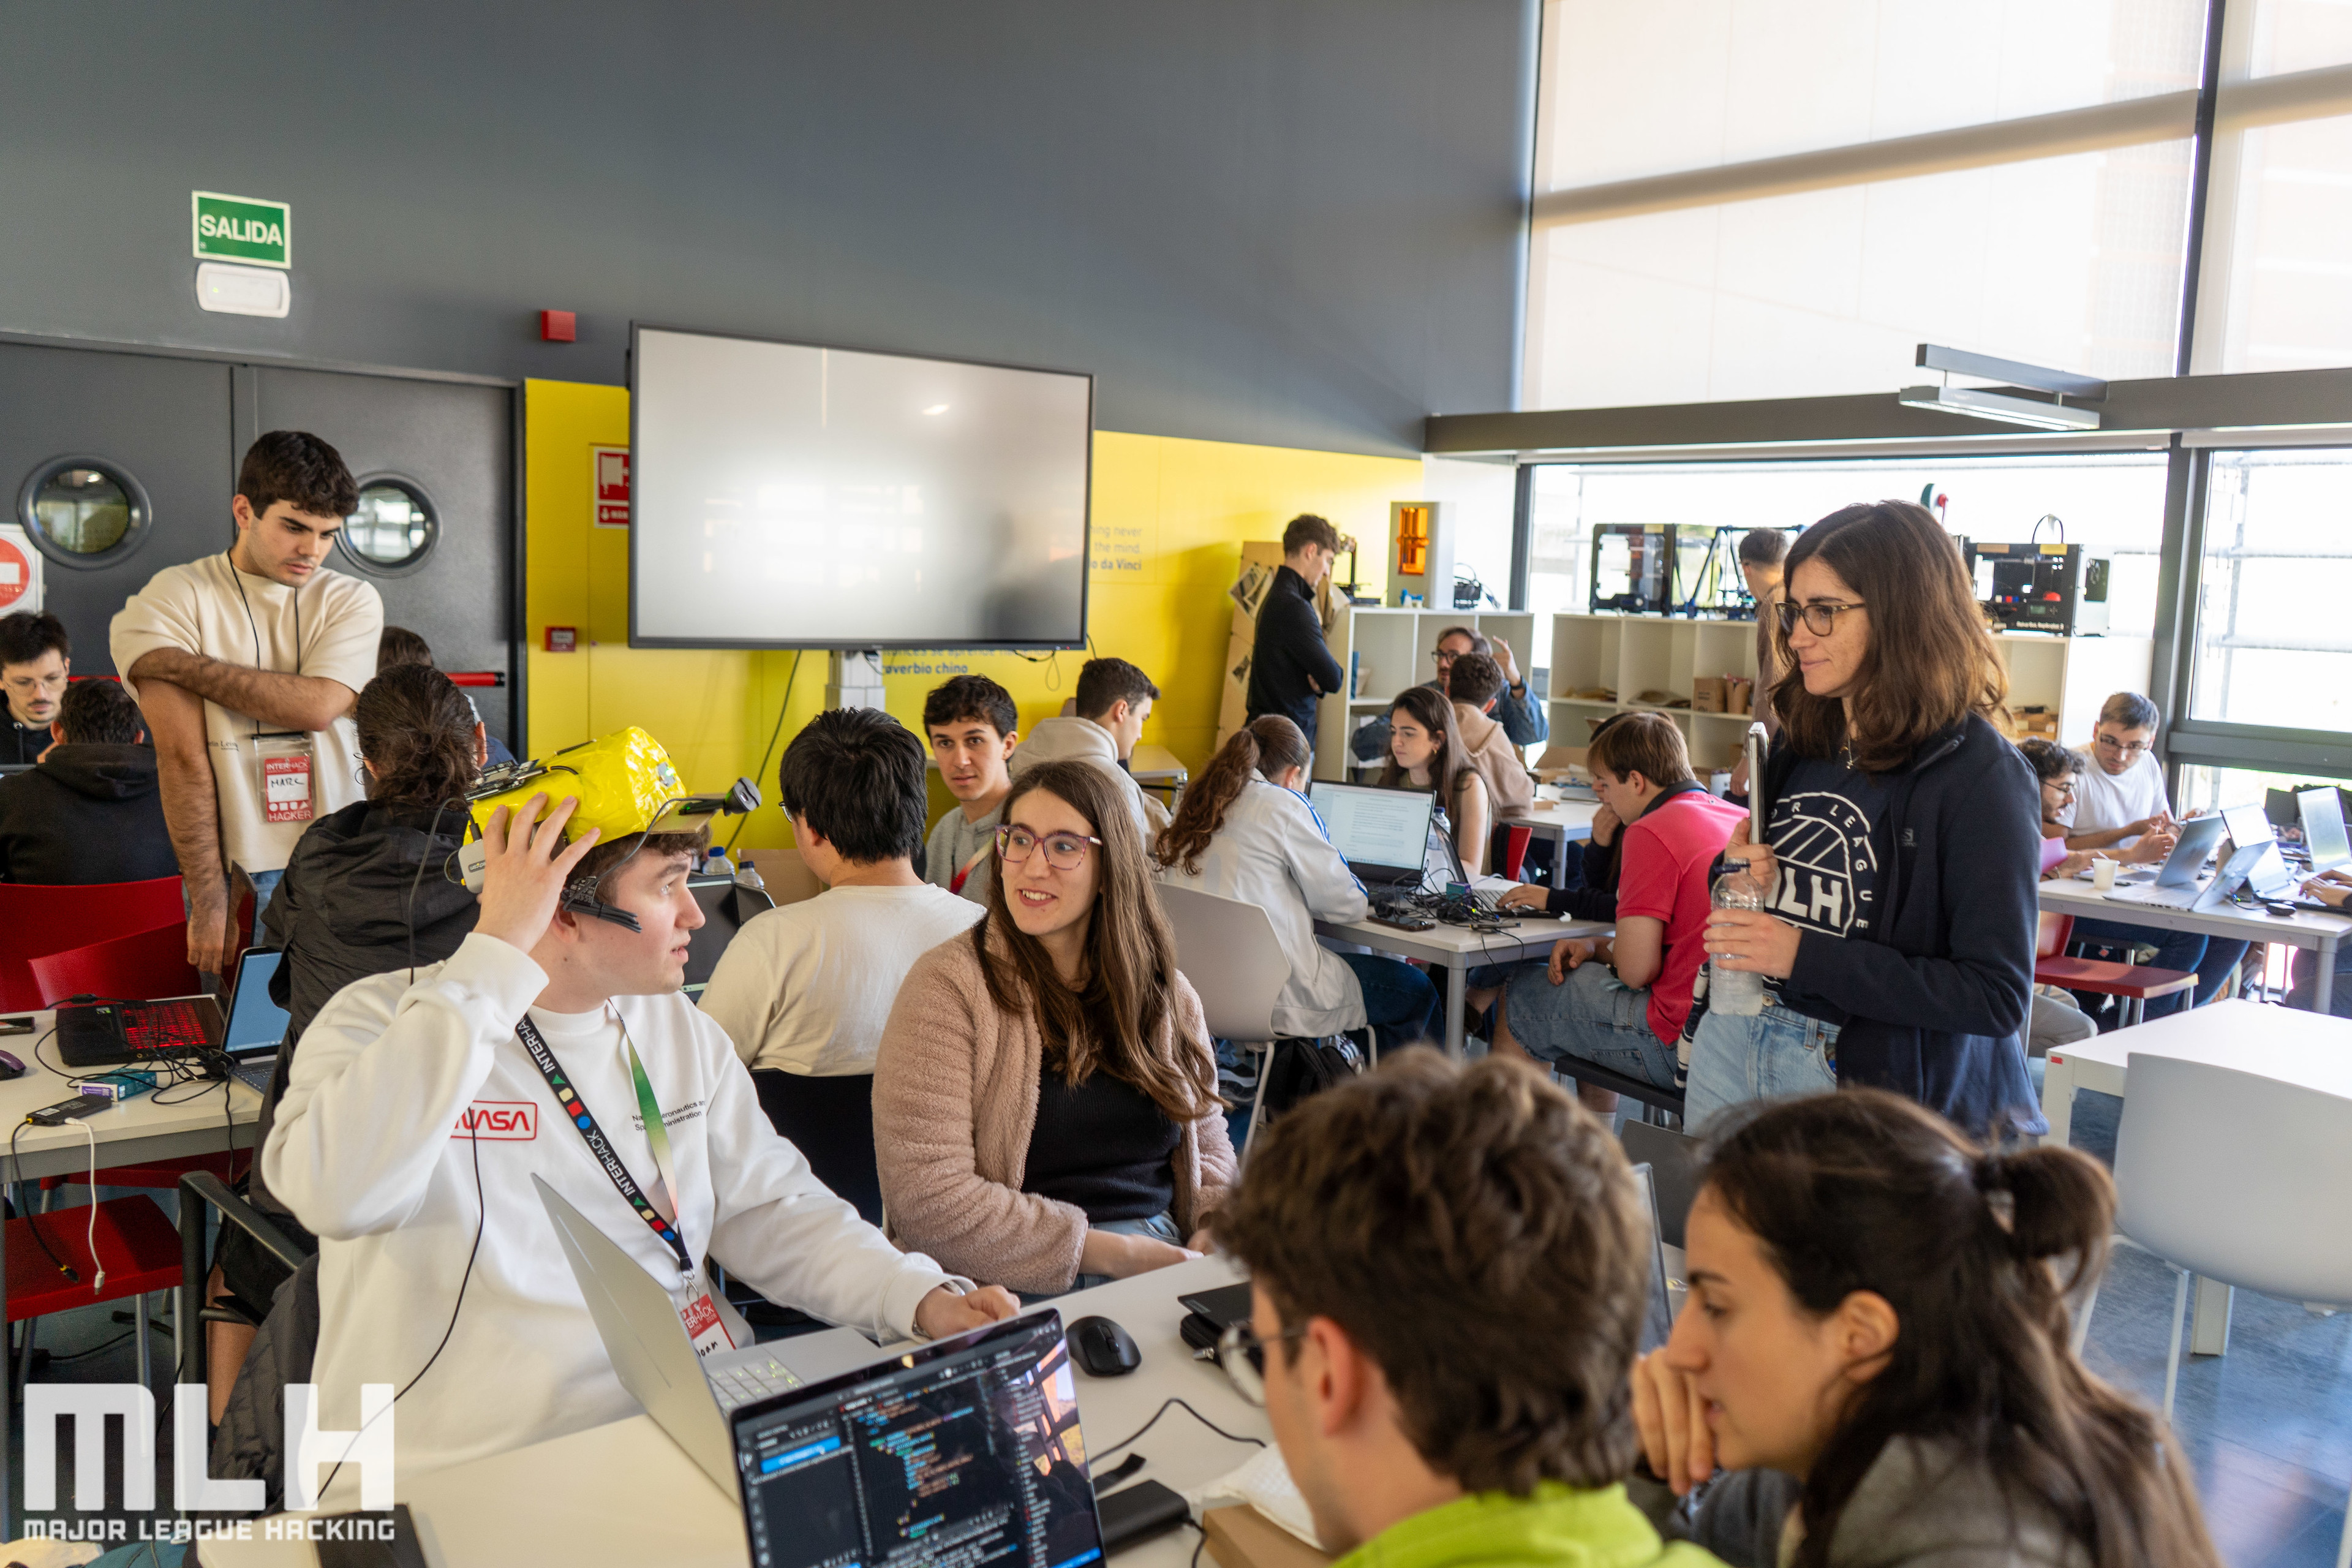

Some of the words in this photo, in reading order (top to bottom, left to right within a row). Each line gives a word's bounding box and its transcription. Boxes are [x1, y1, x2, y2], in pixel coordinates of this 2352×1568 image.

[200, 214, 283, 246] SALIDA
[1114, 527, 1142, 537] never
[1095, 542, 1110, 552] the
[1101, 559, 1113, 570] da
[1116, 559, 1142, 570] Vinci
[935, 662, 968, 674] chino
[269, 810, 311, 821] HACKER
[518, 1016, 556, 1073] INTERHA
[662, 1102, 698, 1118] eronautics
[663, 1111, 702, 1128] ministration
[586, 1130, 636, 1196] INTERHACK
[685, 1303, 714, 1329] ERHACK
